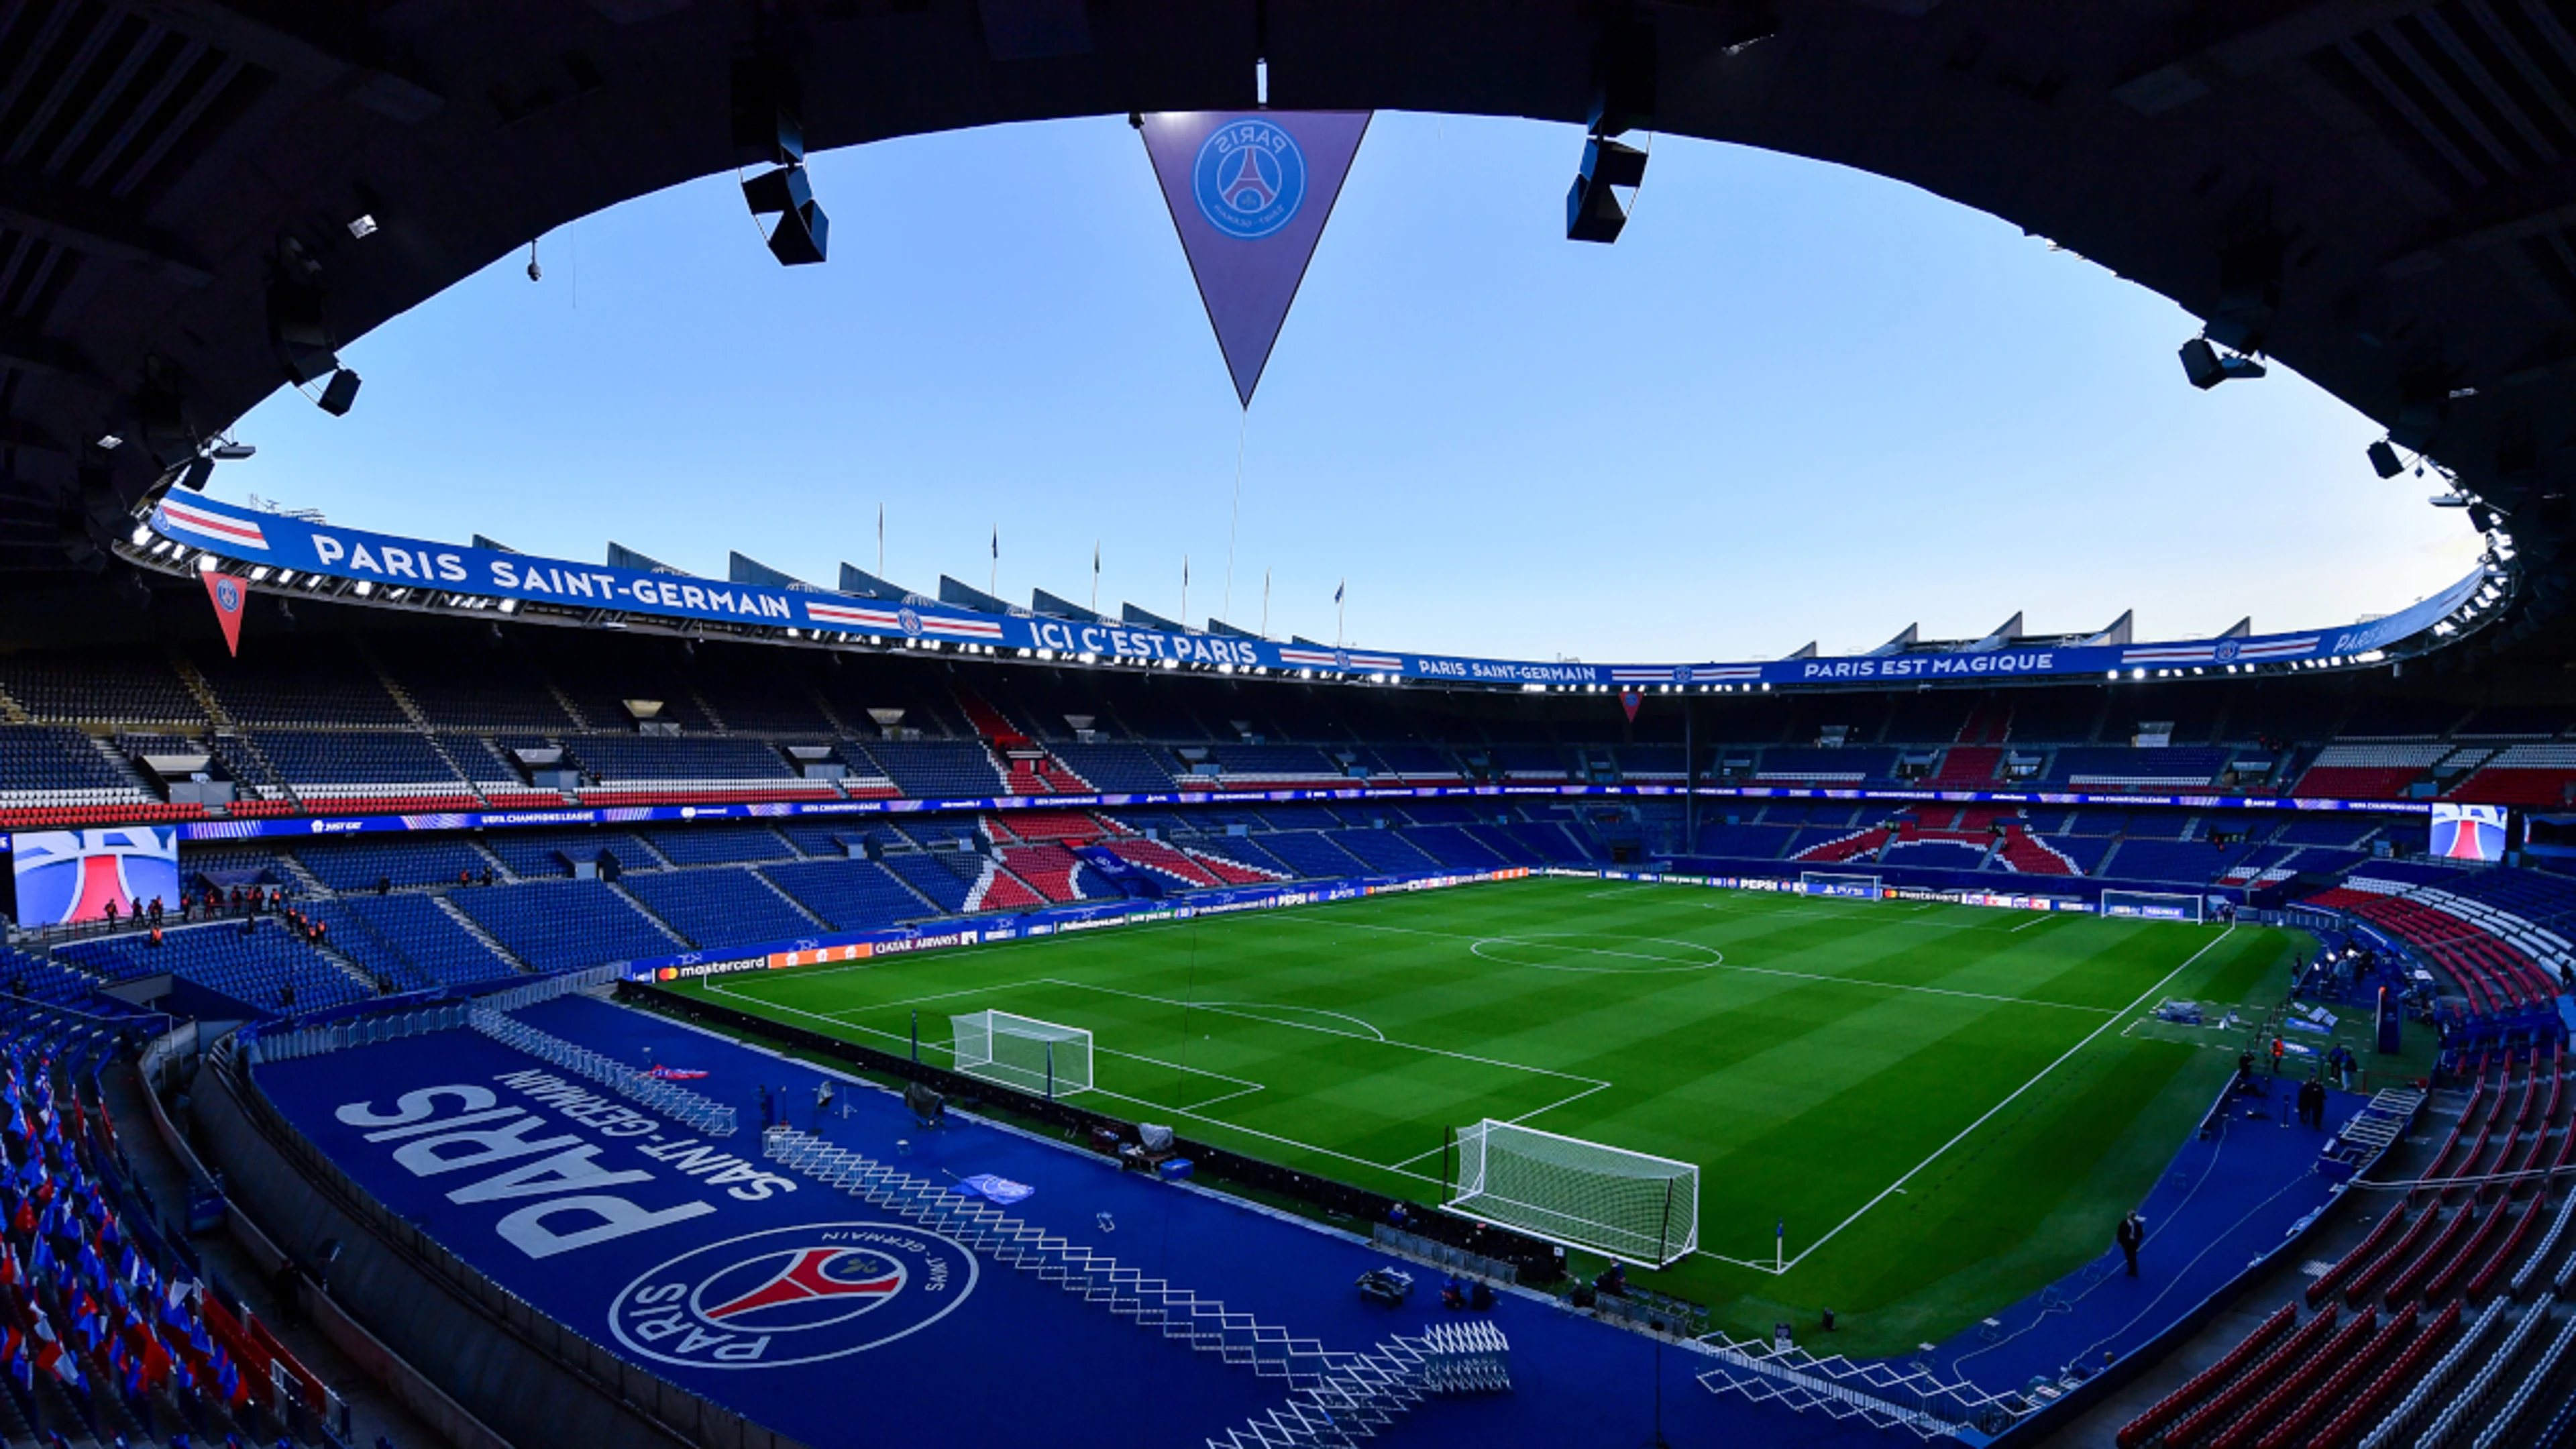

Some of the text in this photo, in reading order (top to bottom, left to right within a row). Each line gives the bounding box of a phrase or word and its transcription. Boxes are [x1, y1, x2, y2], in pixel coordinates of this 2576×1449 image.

[311, 534, 791, 620] PARIS SAINT-GERMAIN
[1028, 621, 1258, 664] ICI C'EST PARIS
[1417, 659, 1597, 681] PARIS SAINT-GERMAIN
[1804, 653, 2053, 678] PARIS EST MAGIQUE
[875, 934, 958, 953] QATAR AIRWAYS
[681, 957, 765, 977] mastercard
[493, 1068, 798, 1201] SAINT-GERMAIN
[335, 1083, 718, 1258] PARIS
[629, 1283, 772, 1360] PARIS
